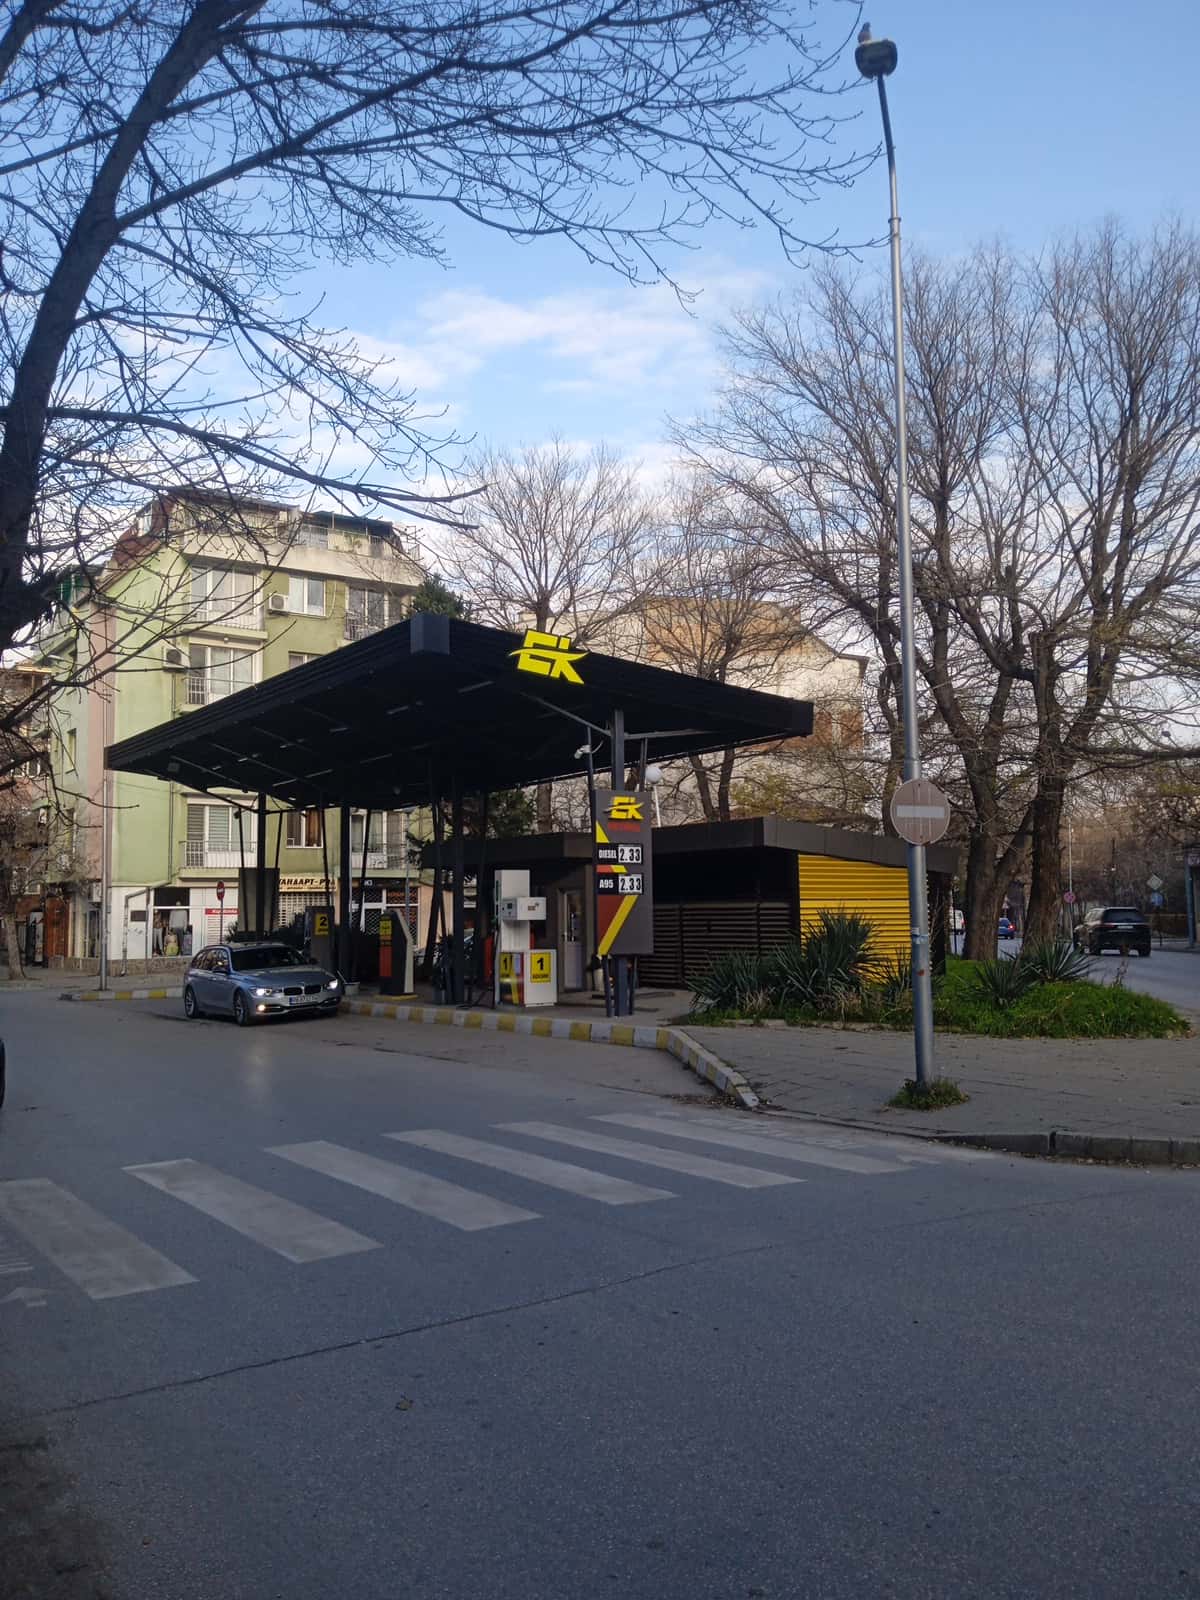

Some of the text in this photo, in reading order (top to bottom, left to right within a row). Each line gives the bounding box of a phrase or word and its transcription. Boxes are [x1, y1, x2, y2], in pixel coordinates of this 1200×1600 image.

[598, 847, 641, 861] DIESEL 2.33
[620, 878, 642, 891] 2.33
[319, 916, 328, 927] 2
[503, 957, 508, 971] 1
[536, 957, 544, 971] 1
